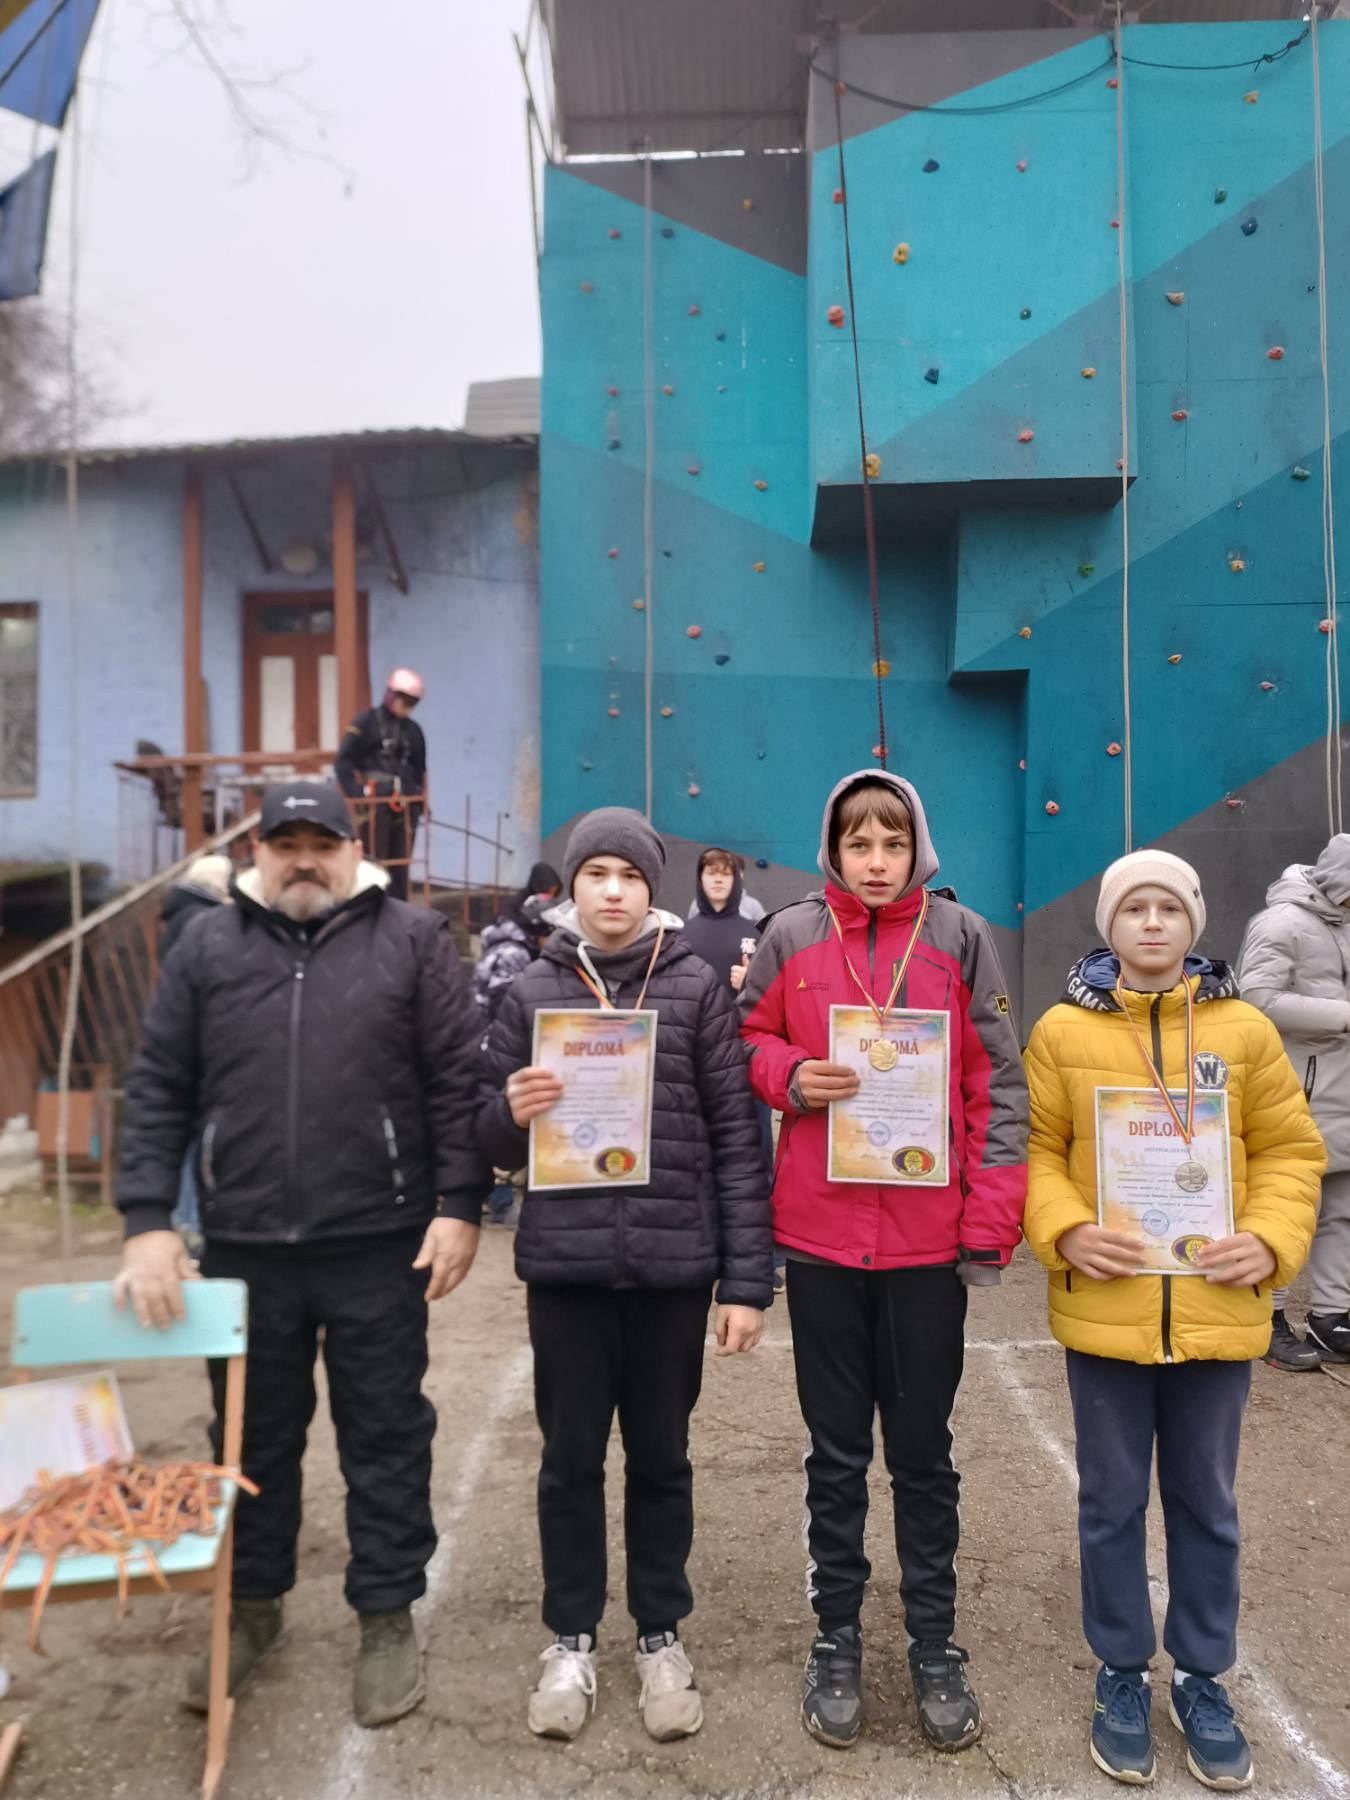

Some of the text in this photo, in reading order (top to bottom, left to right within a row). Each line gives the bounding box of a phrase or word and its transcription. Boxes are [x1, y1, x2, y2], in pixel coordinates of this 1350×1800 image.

[859, 1038, 920, 1056] DIOMĂ
[1197, 1061, 1219, 1084] W
[1128, 1120, 1197, 1138] DIPLO
